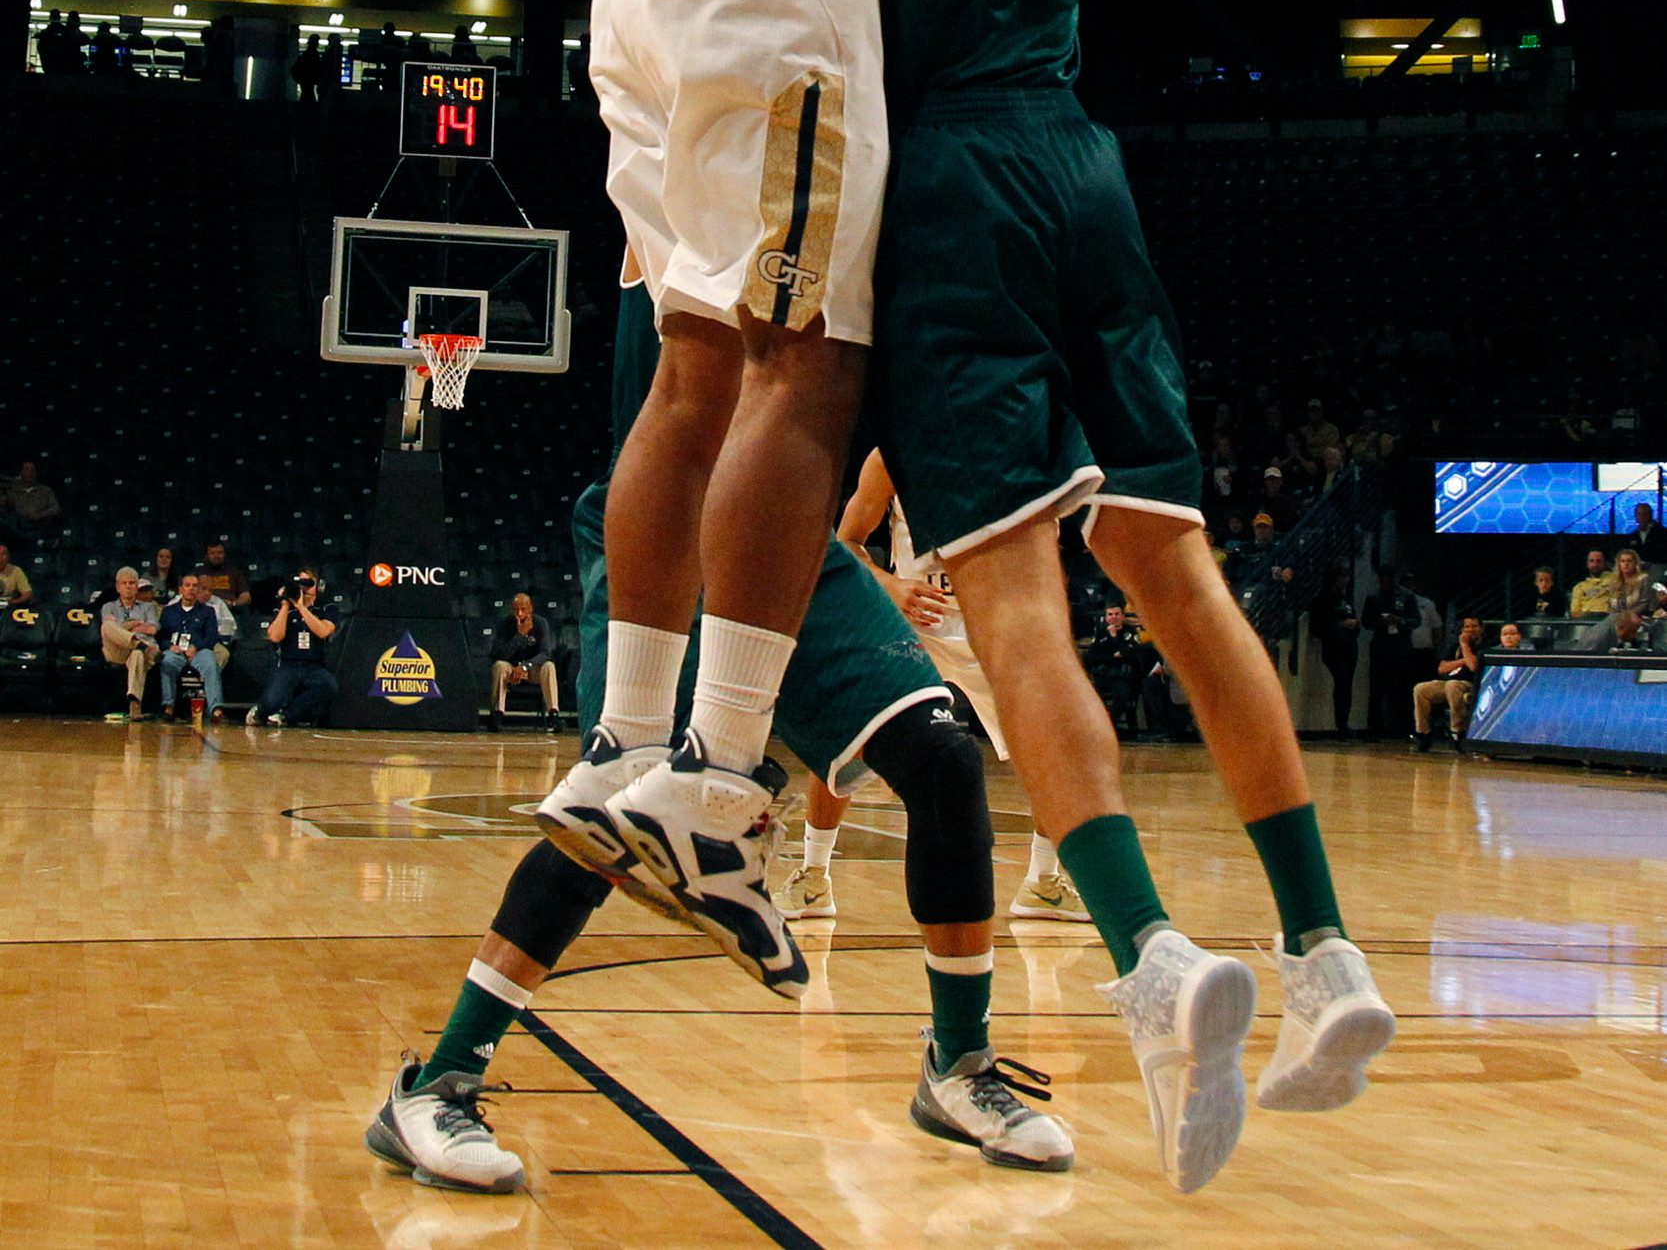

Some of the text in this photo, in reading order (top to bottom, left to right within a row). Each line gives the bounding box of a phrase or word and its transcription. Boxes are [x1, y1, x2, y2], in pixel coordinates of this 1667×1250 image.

[436, 104, 476, 146] 14
[396, 566, 446, 586] PNC
[380, 659, 431, 677] Superior
[381, 679, 429, 694] PLUMBING
